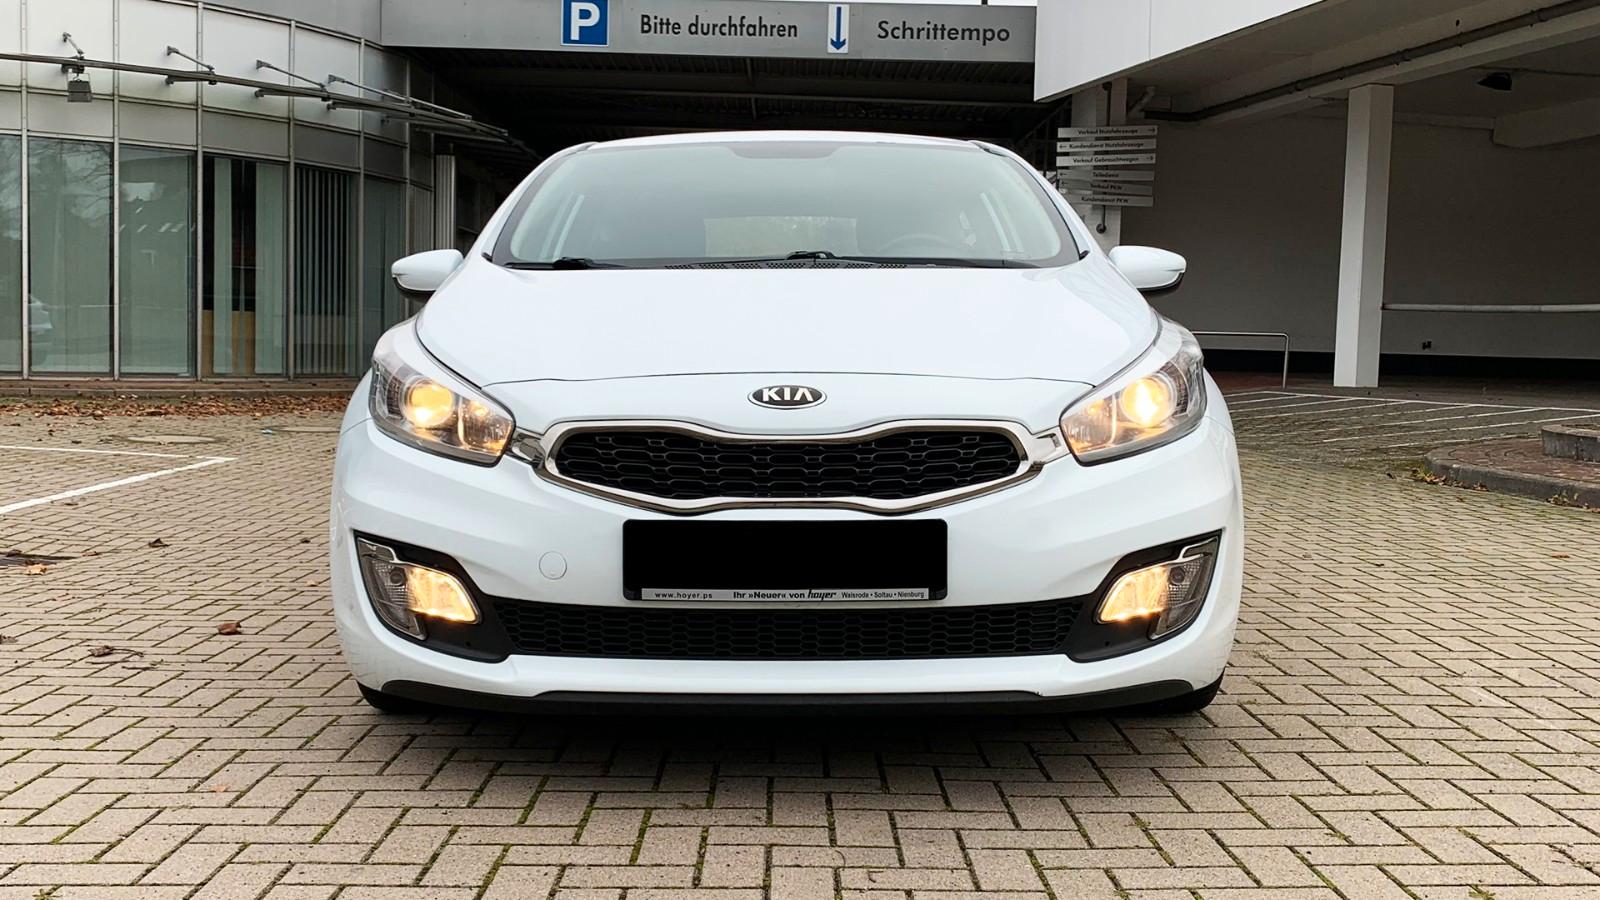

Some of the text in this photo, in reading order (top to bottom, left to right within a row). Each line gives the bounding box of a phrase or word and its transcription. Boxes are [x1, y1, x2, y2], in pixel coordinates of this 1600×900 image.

[570, 2, 600, 40] P
[640, 14, 798, 37] Bitte durchfahren
[877, 20, 1010, 46] Schrittempo
[762, 387, 814, 401] KIA
[655, 592, 713, 600] www.hoyer.ps
[733, 591, 746, 599] Ihr
[808, 589, 836, 601] hoyer
[898, 591, 925, 599] Nienburg
